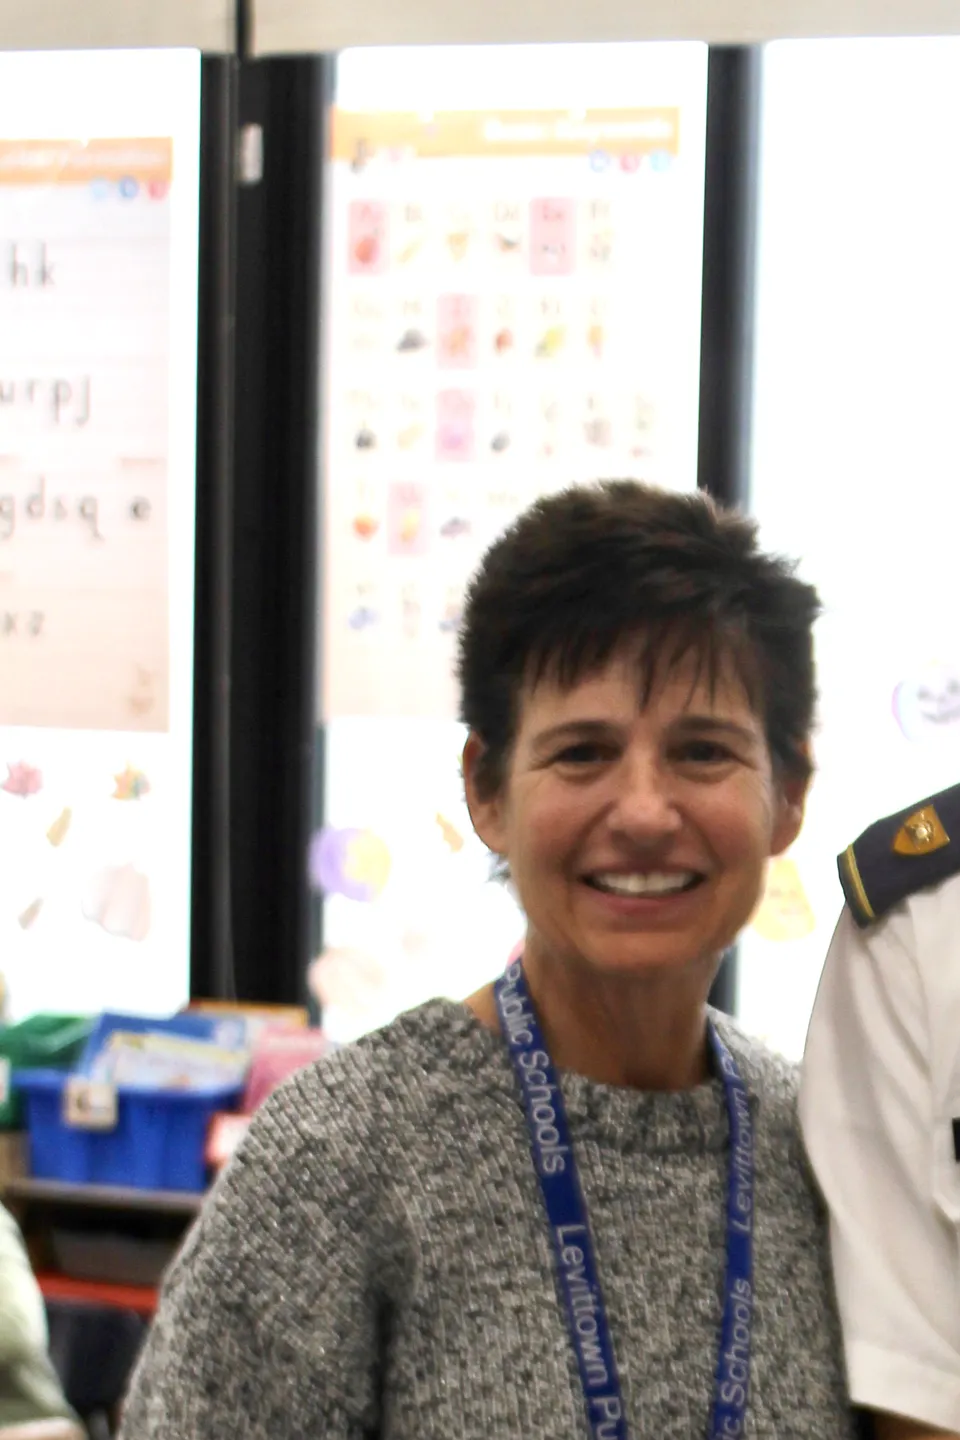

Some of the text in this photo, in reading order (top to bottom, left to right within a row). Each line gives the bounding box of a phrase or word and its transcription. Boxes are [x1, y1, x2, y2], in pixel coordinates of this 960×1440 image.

[518, 1050, 569, 1175] Schools
[728, 1086, 753, 1233] Levittown
[555, 1222, 610, 1387] Levittown
[720, 1278, 752, 1408] Schools
